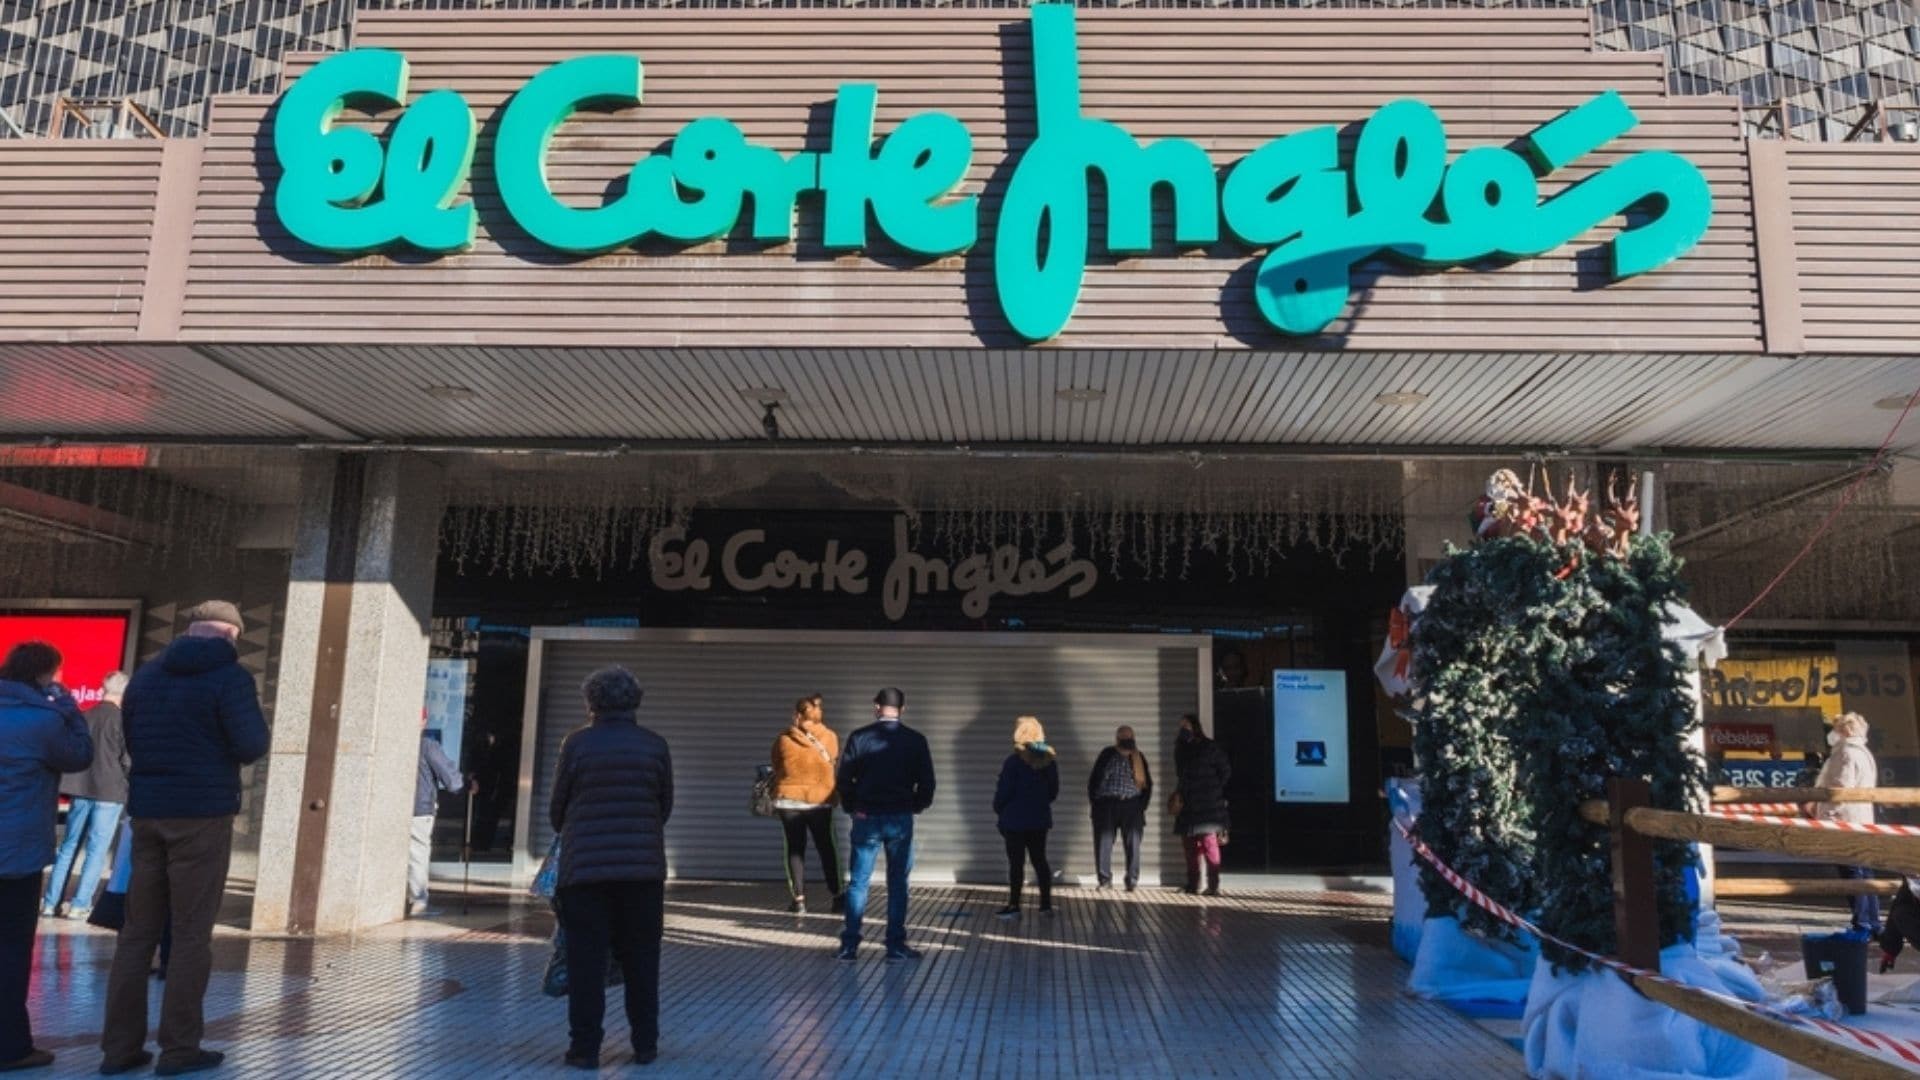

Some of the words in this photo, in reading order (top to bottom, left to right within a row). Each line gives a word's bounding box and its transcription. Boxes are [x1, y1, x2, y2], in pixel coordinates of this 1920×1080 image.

[274, 48, 480, 252] El
[494, 54, 978, 255] Corte
[994, 3, 1713, 341] Inglés
[649, 524, 710, 591] El
[721, 529, 868, 593] Corte
[883, 514, 1098, 620] Inglés
[70, 684, 104, 704] ajas
